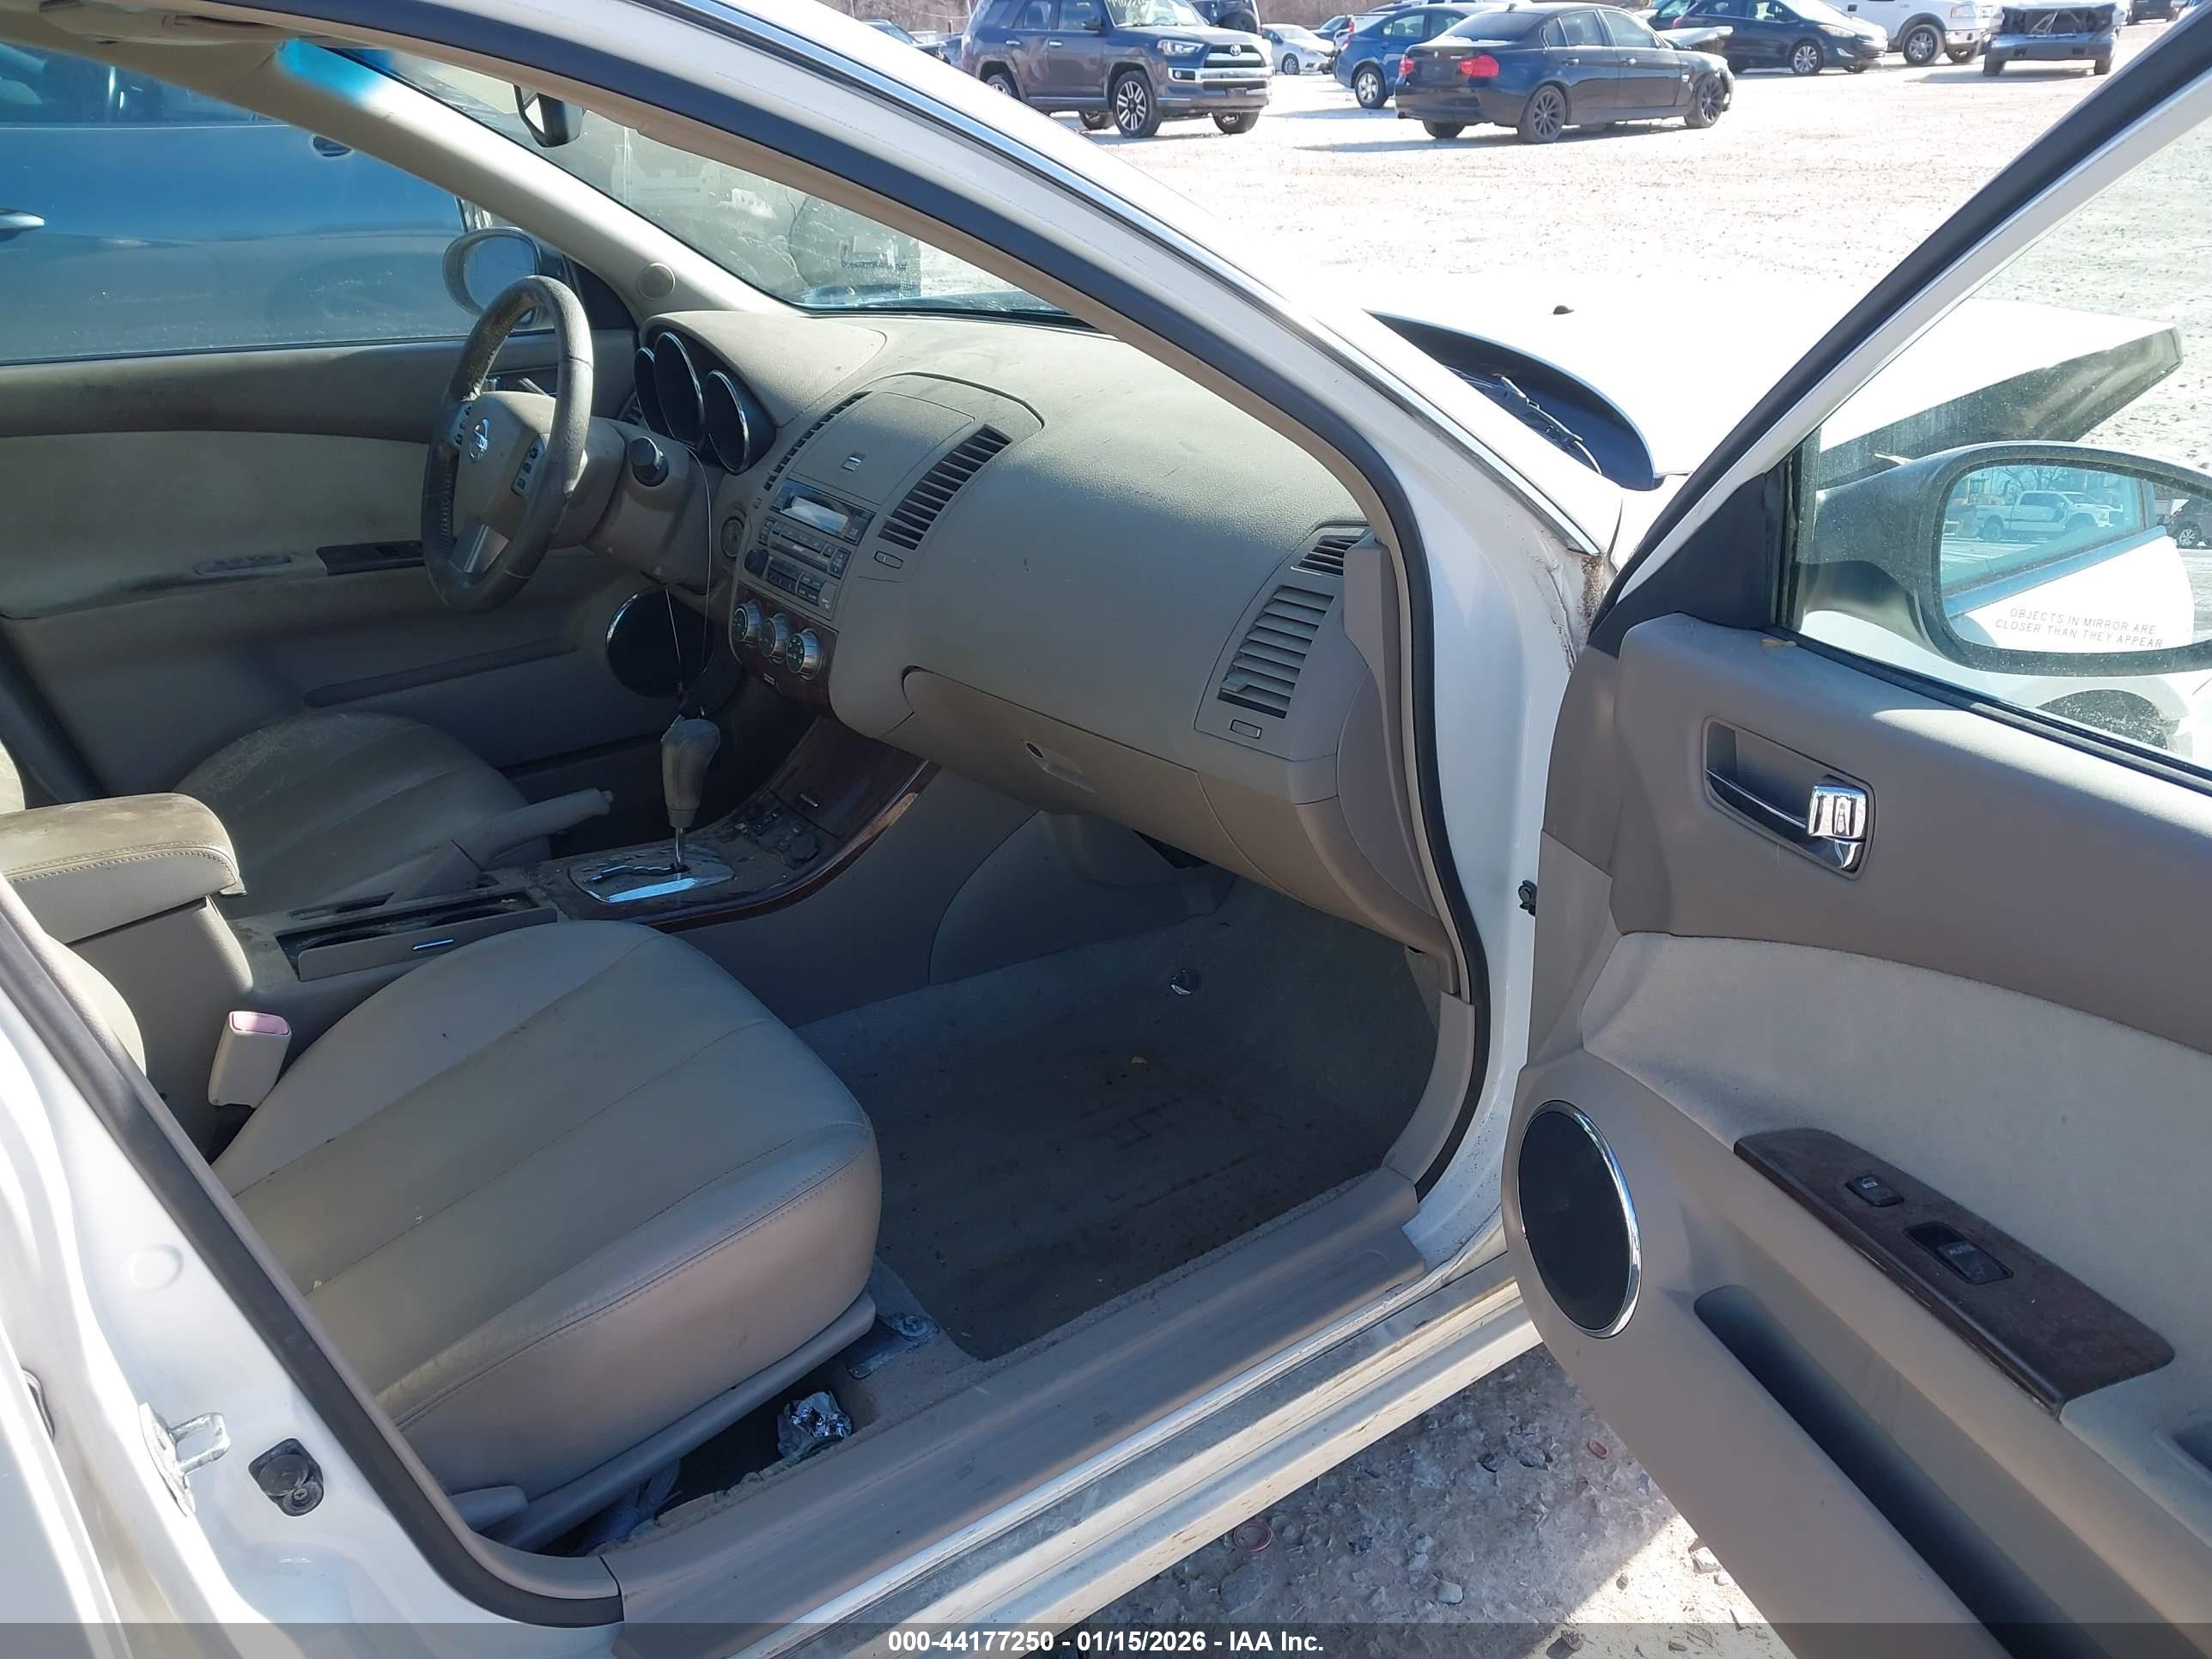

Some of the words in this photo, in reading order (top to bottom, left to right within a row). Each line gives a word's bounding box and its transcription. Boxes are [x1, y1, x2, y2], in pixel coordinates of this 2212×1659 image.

[1995, 618, 2041, 633] CLOSER
[2047, 625, 2077, 640] THAN
[2082, 629, 2113, 642] THEY
[2116, 635, 2164, 648] APPEAR
[2009, 608, 2064, 624] OBJECTS
[2068, 616, 2079, 626] IN
[2083, 617, 2130, 632] MIRROR
[2132, 624, 2157, 635] ARE
[1948, 1243, 1974, 1255] AUTO
